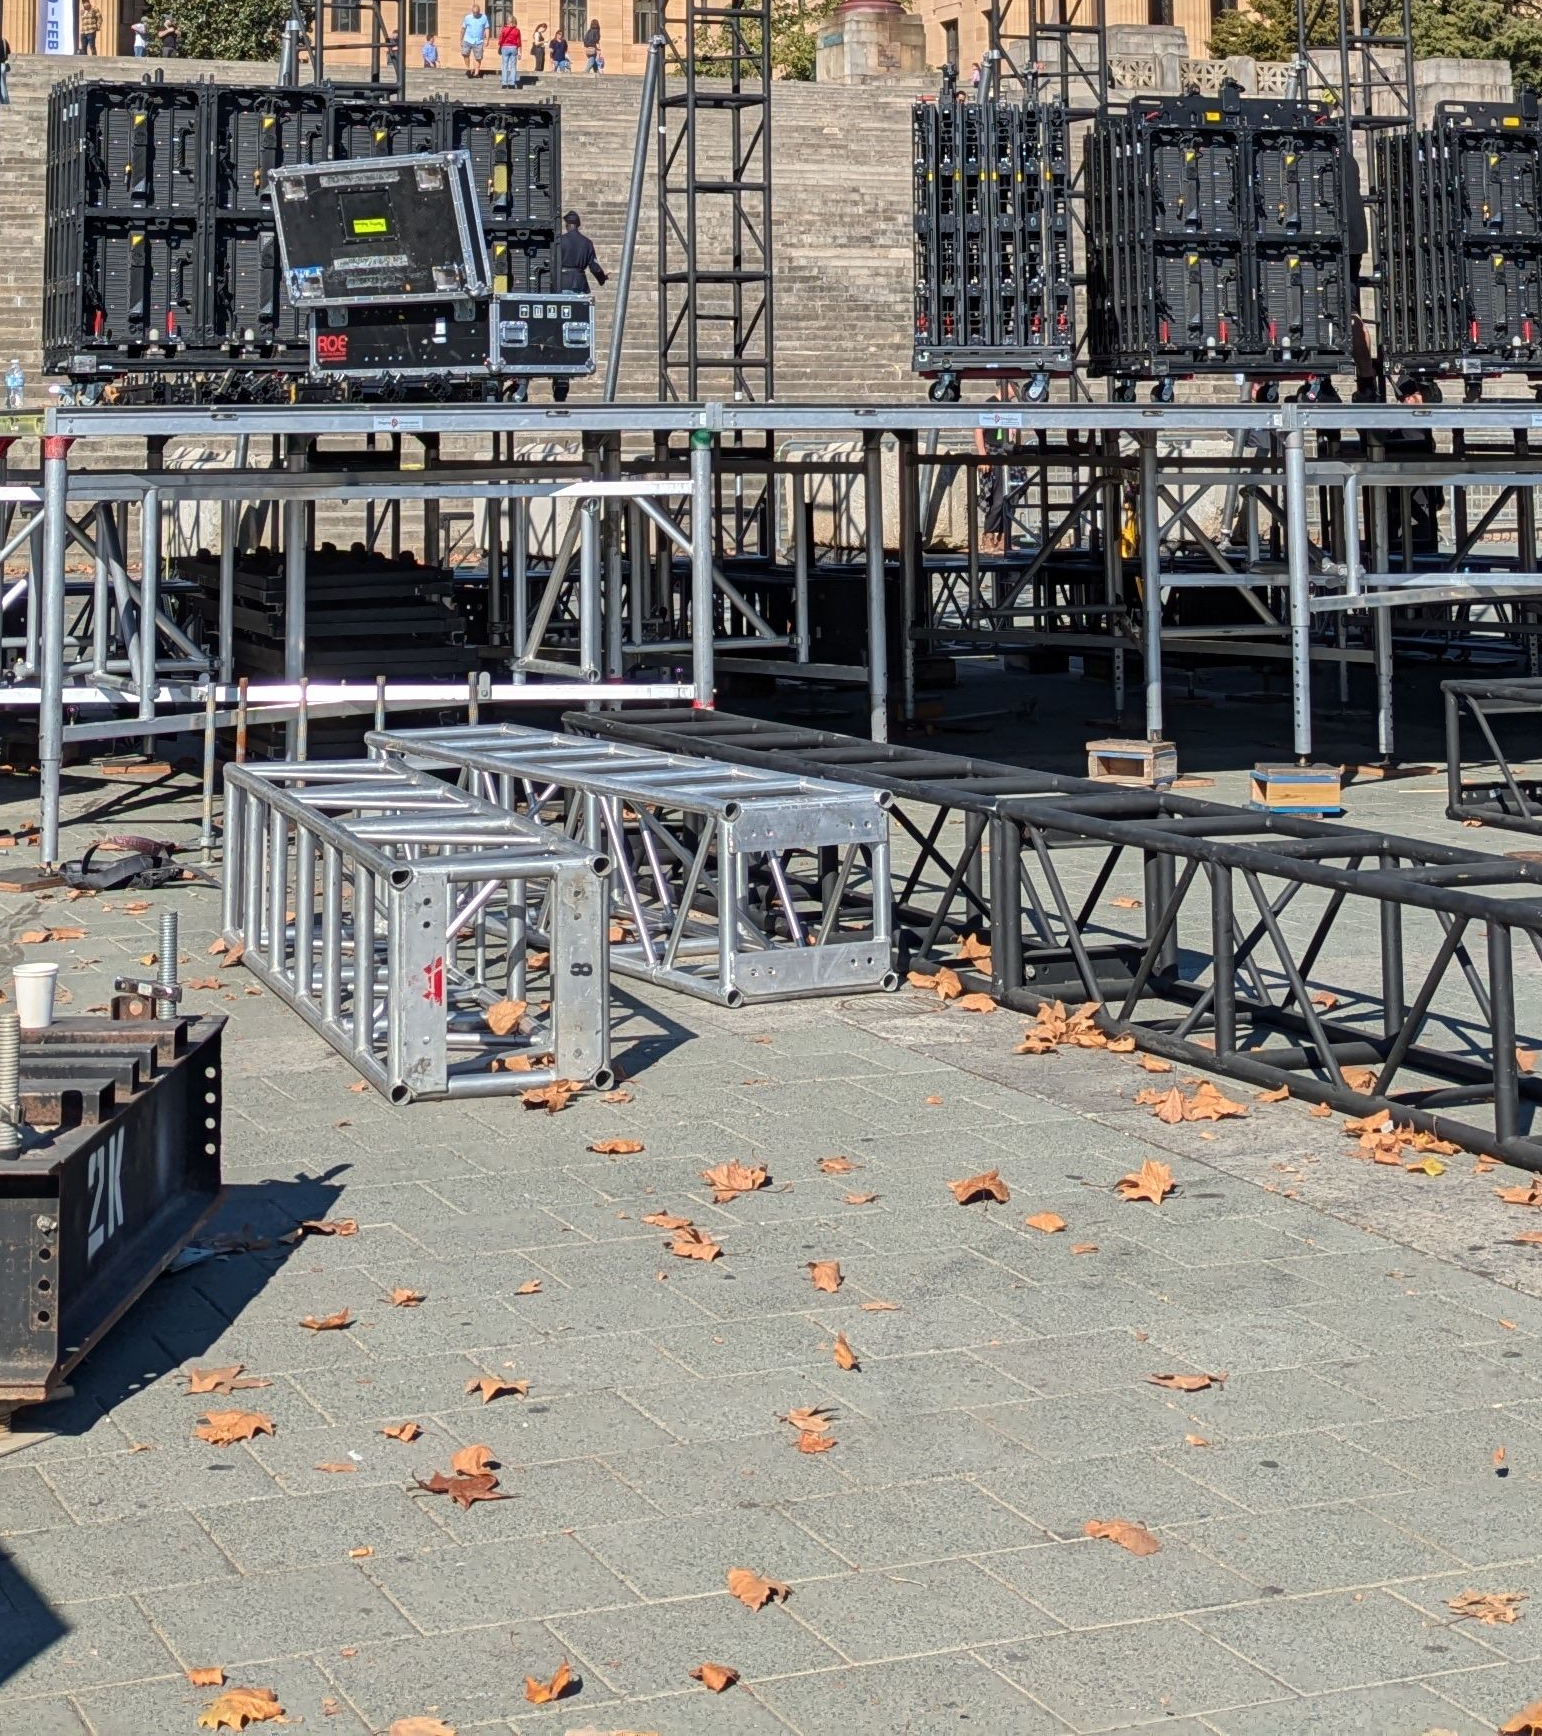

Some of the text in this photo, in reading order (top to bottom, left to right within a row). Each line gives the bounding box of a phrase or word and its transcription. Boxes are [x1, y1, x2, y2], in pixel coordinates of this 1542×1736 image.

[47, 20, 59, 50] FEB
[317, 334, 347, 352] ROE
[87, 1125, 125, 1262] 2K
